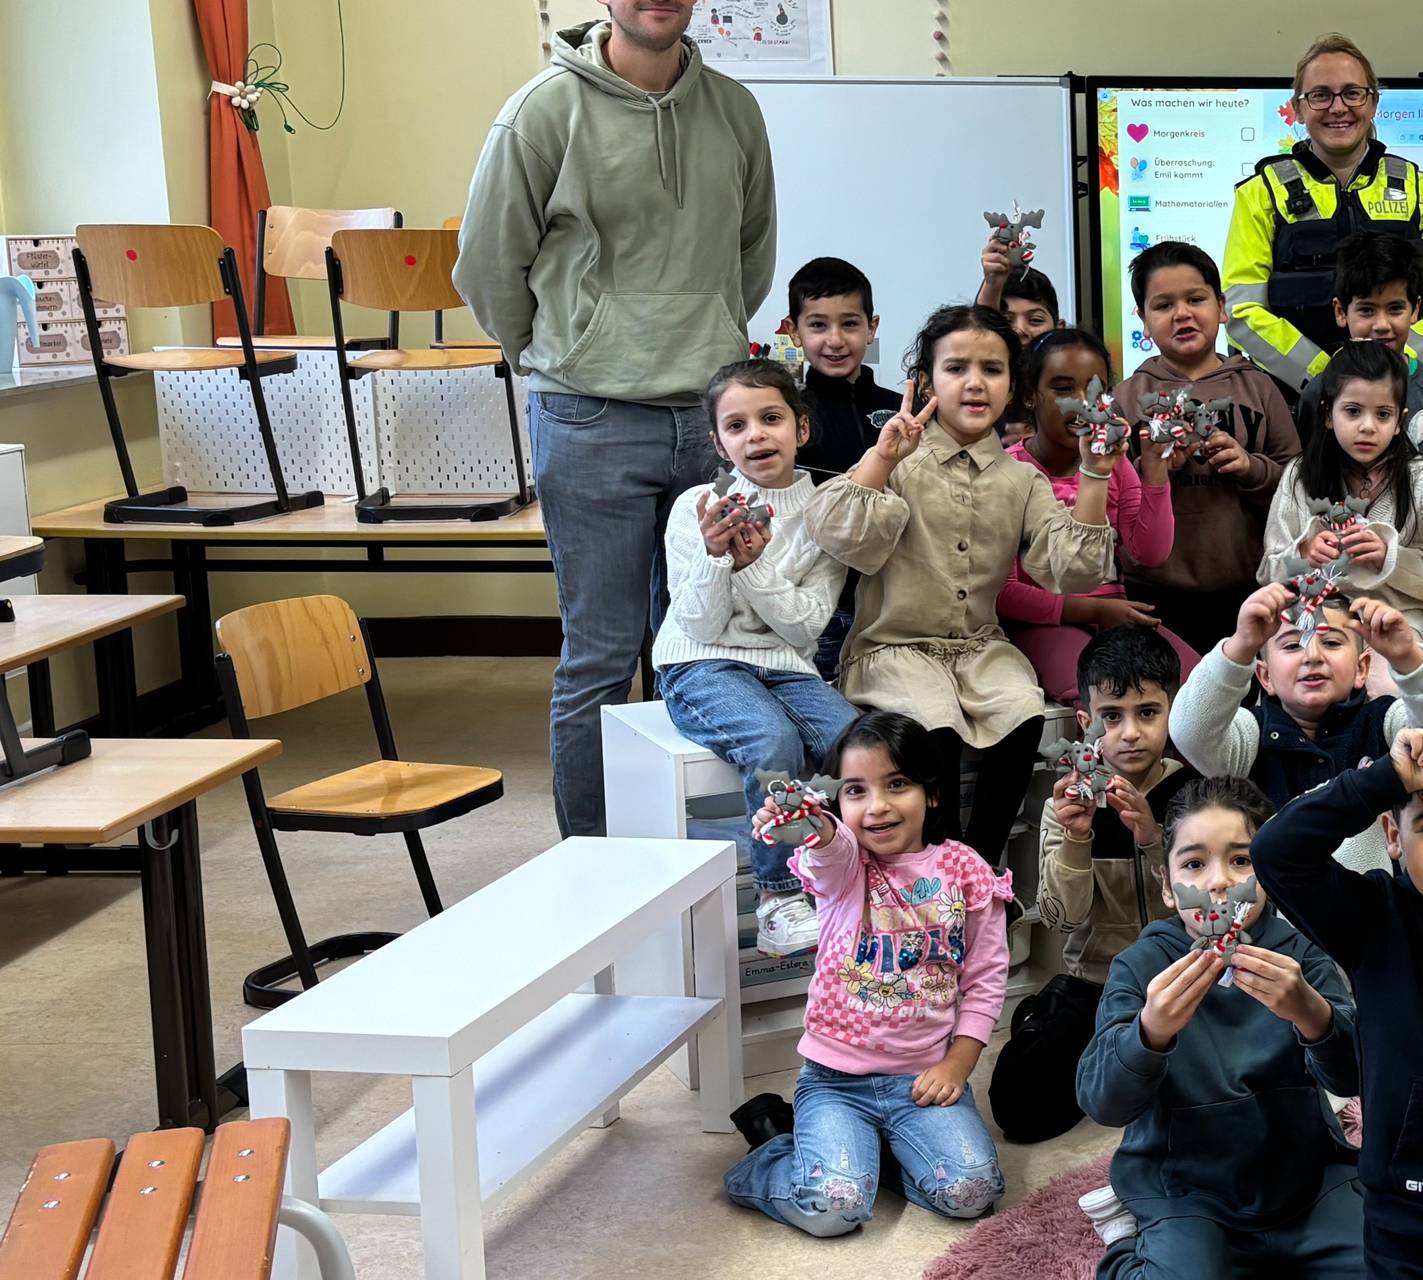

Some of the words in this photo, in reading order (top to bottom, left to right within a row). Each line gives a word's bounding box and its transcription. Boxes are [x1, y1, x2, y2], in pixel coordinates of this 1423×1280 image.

[1131, 99, 1152, 108] Was
[1155, 99, 1195, 108] machen
[1198, 99, 1212, 108] wir
[1216, 99, 1250, 108] heute?
[1153, 130, 1205, 139] Morgenkreis
[1154, 157, 1216, 169] Überraschung:
[1154, 171, 1172, 179] Emil
[1174, 171, 1203, 179] kommt
